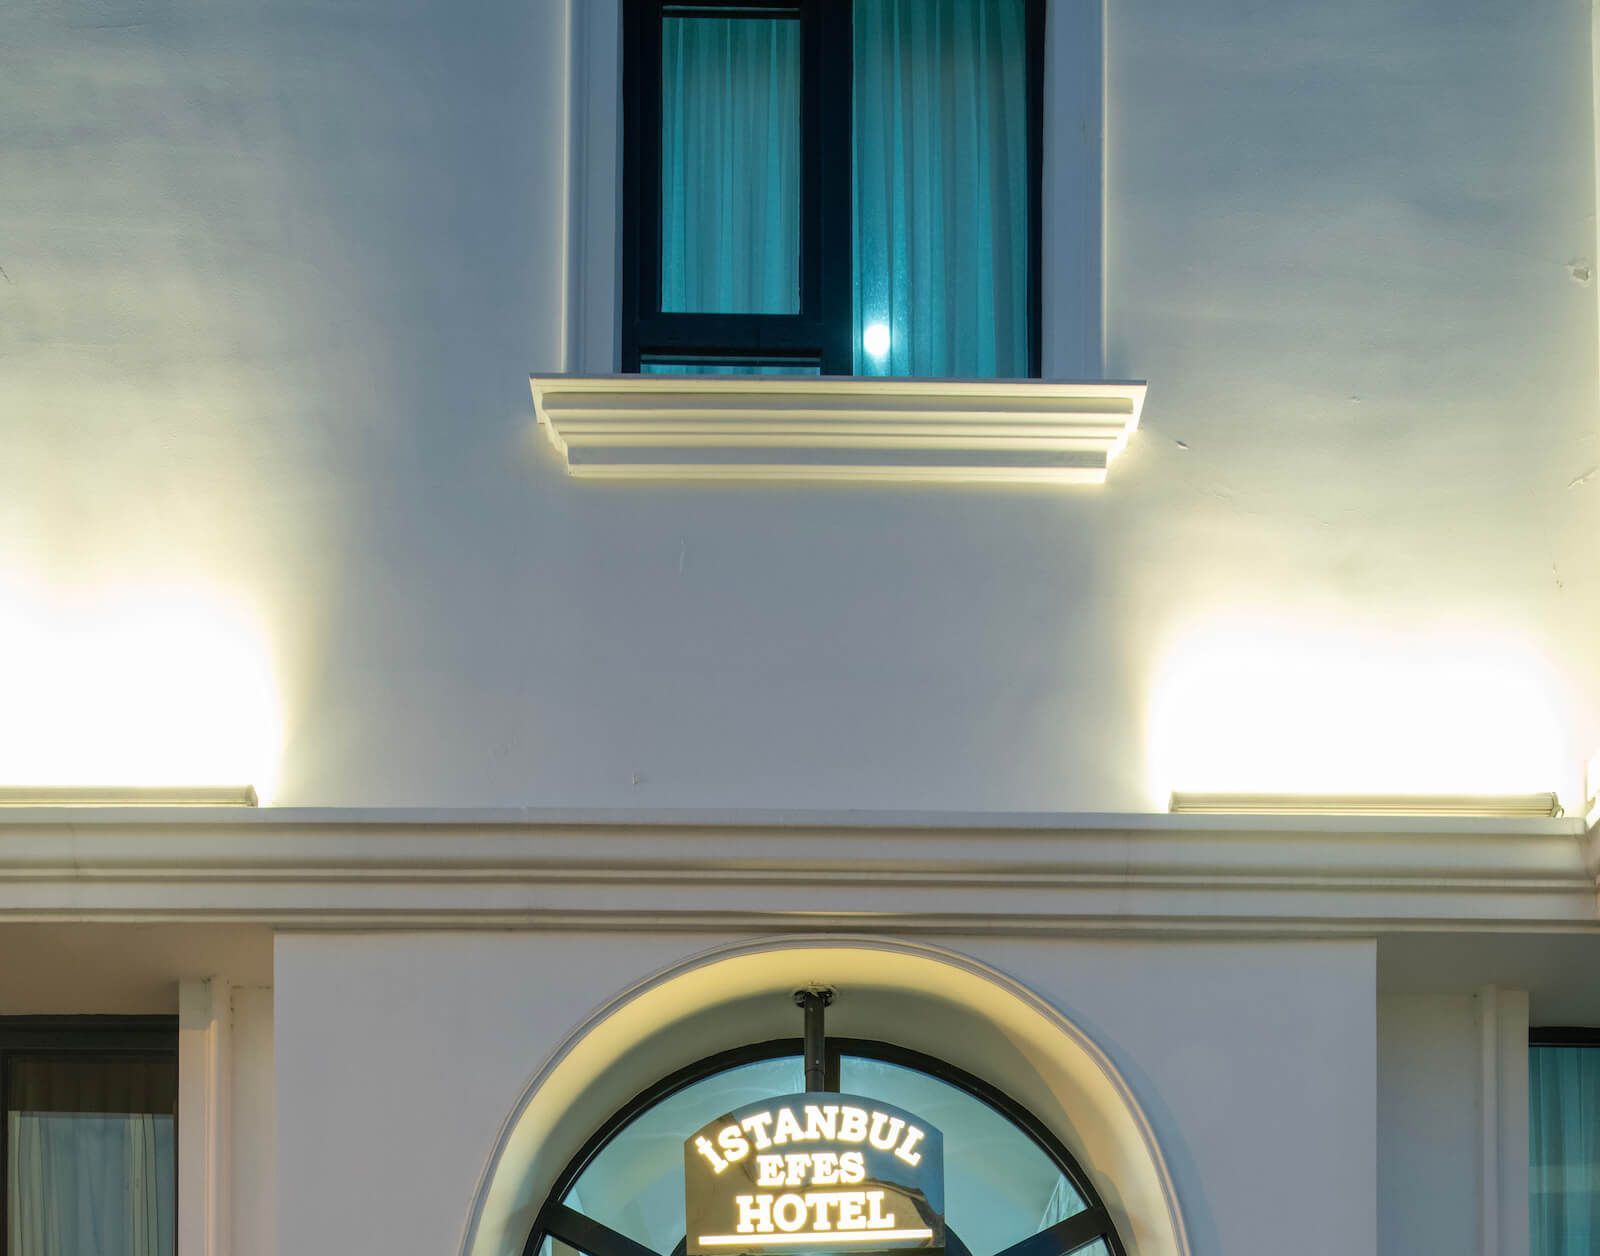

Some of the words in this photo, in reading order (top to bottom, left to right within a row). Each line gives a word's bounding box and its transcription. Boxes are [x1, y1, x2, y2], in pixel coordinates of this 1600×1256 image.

[695, 1104, 925, 1174] İSTANBUL
[757, 1151, 866, 1187] EFES
[735, 1190, 896, 1234] HOTEL
